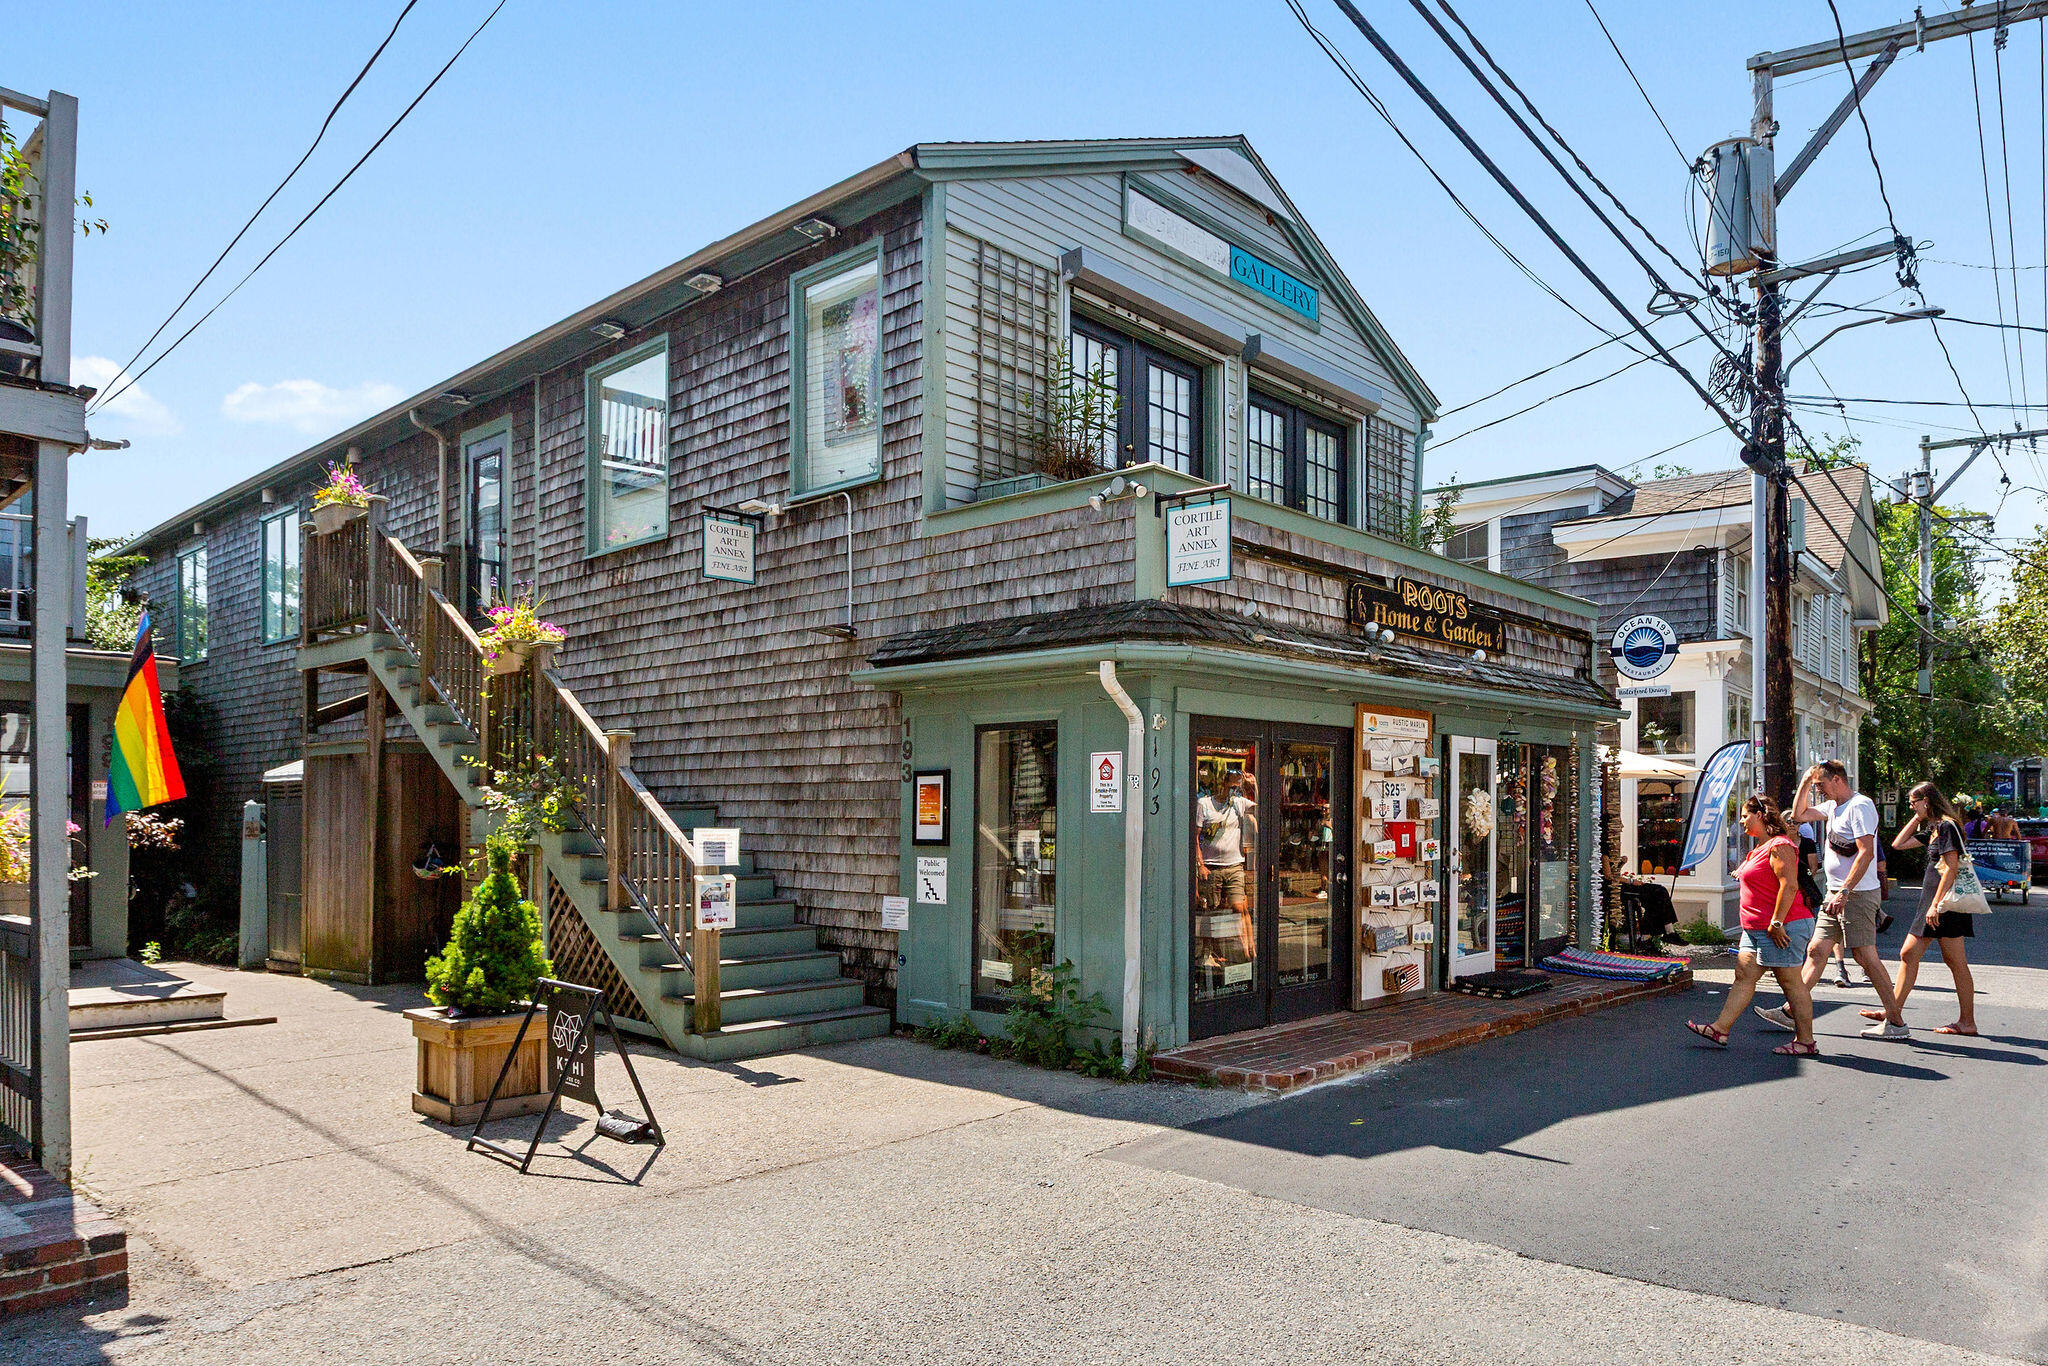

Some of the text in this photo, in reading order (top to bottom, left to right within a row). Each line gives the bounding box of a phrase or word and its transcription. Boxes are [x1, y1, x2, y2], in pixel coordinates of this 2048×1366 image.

[1233, 255, 1314, 312] GALLERY
[1174, 510, 1222, 526] CORTILE
[709, 524, 749, 539] CORTILE
[1186, 525, 1210, 538] ART
[720, 537, 739, 547] ART
[1178, 538, 1218, 553] ANNEX
[713, 546, 745, 559] ANNEX
[711, 561, 748, 573] FINE ART
[1177, 558, 1221, 574] FINE ART
[1402, 580, 1468, 620] ROOTS
[1373, 601, 1492, 648] Home & Garden
[1618, 617, 1671, 639] OCEAN 193
[1623, 664, 1664, 676] RESTAURANT
[1392, 718, 1409, 727] RUSTIC
[1410, 719, 1426, 729] MARLIN
[902, 717, 913, 783] 193
[1150, 736, 1160, 815] 193
[1385, 782, 1400, 797] $25
[1884, 793, 1896, 801] 15
[1688, 756, 1735, 855] OPEN
[923, 859, 941, 867] Public
[919, 869, 945, 877] Welcomed
